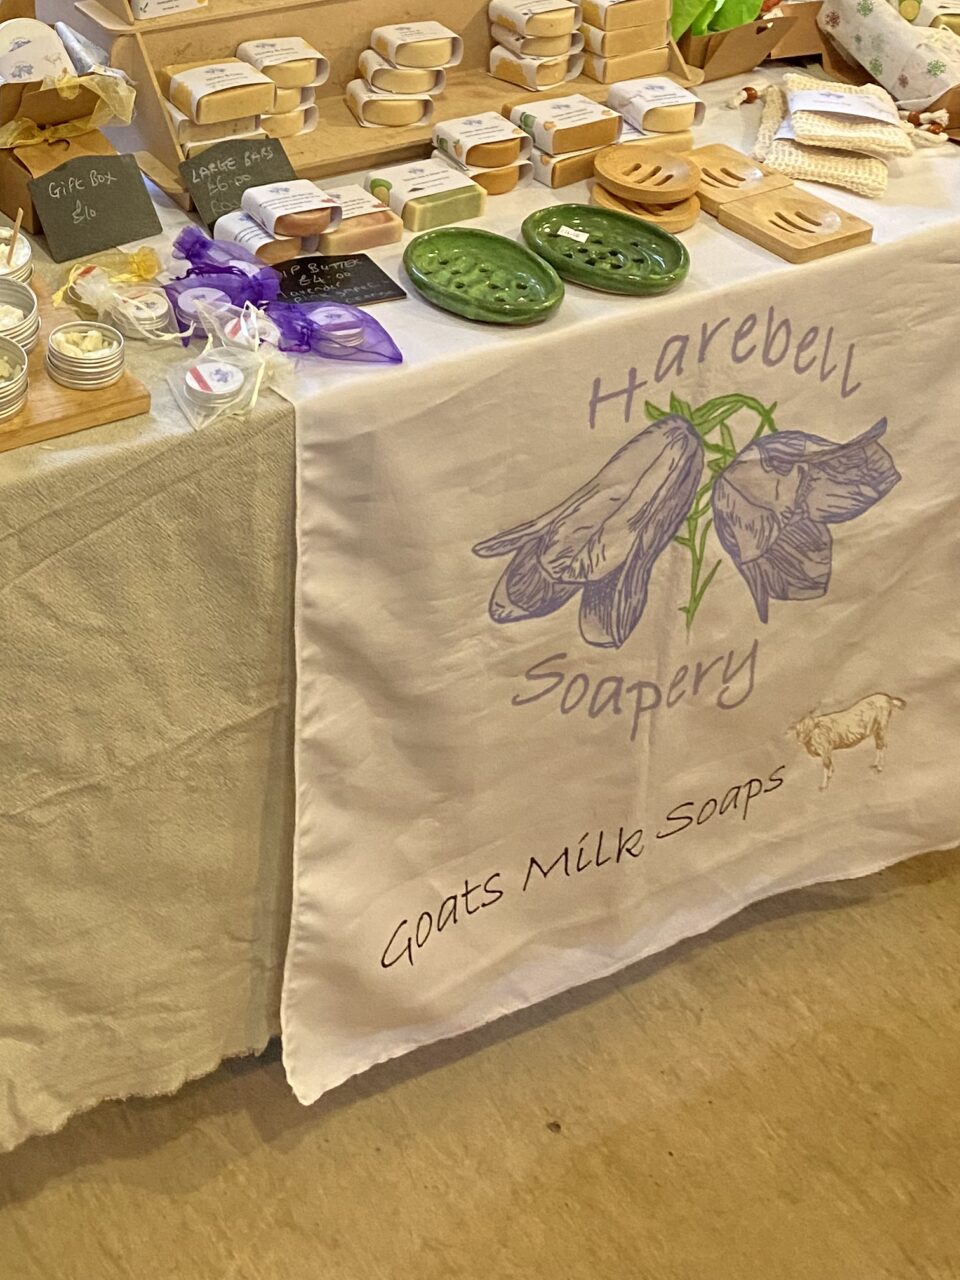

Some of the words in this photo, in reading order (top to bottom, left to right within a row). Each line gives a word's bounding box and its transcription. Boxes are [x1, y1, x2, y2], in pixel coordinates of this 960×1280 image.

[90, 170, 117, 186] Box
[192, 157, 236, 184] LARGE
[244, 146, 274, 166] BARS
[72, 200, 96, 224] £10
[589, 305, 862, 429] Harebell
[512, 638, 758, 742] Soapery
[380, 872, 504, 968] Goats
[523, 826, 645, 892] Milk
[656, 765, 786, 840] Soaps
